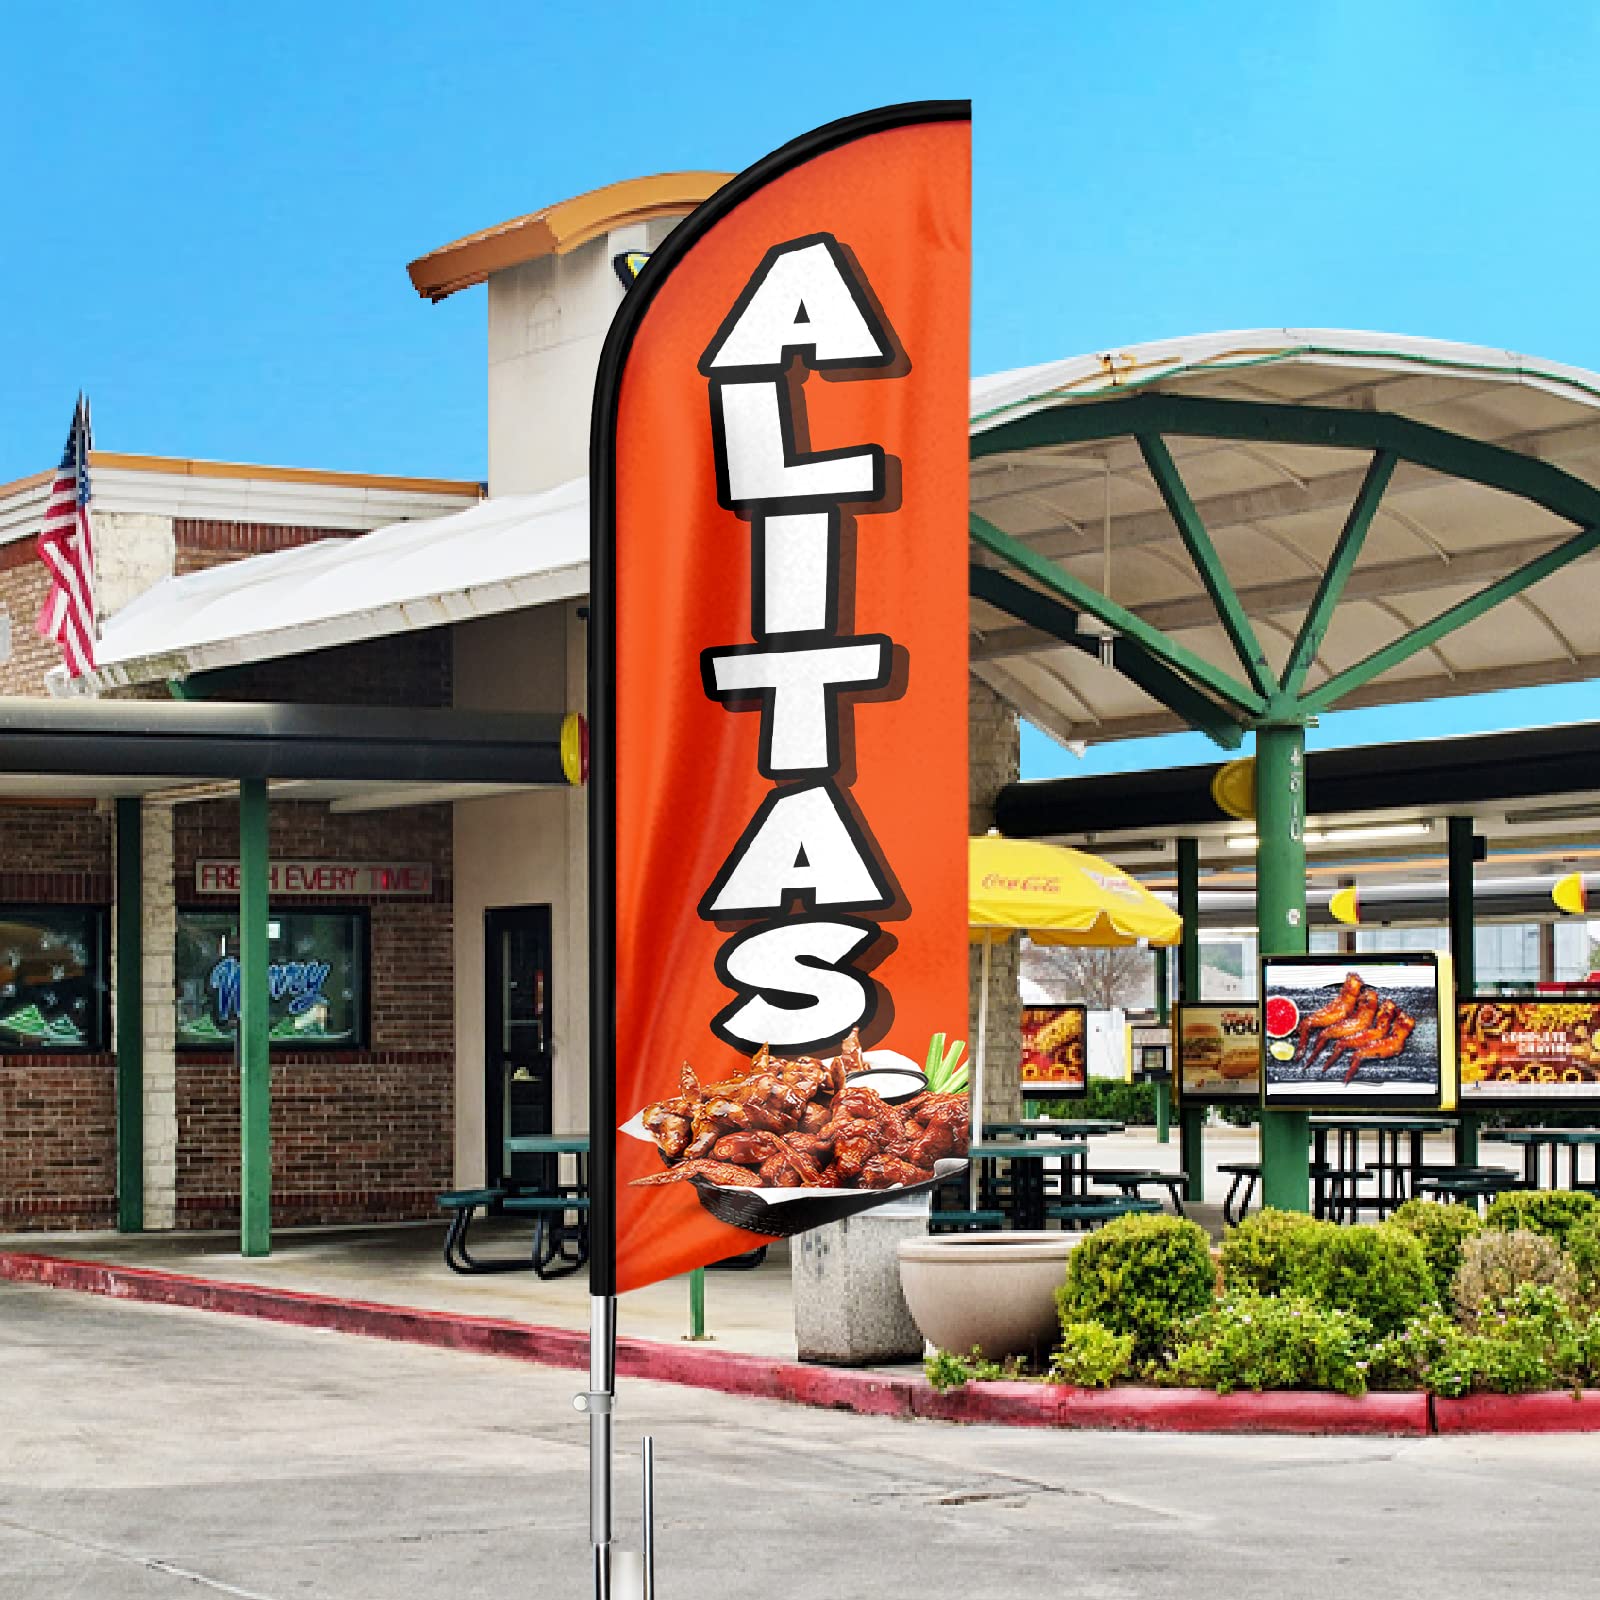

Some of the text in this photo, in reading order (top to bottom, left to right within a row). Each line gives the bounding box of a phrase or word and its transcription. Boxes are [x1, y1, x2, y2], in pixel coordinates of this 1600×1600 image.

[699, 232, 904, 1050] ALITAS
[201, 864, 280, 889] FREH
[285, 864, 360, 890] EVERY
